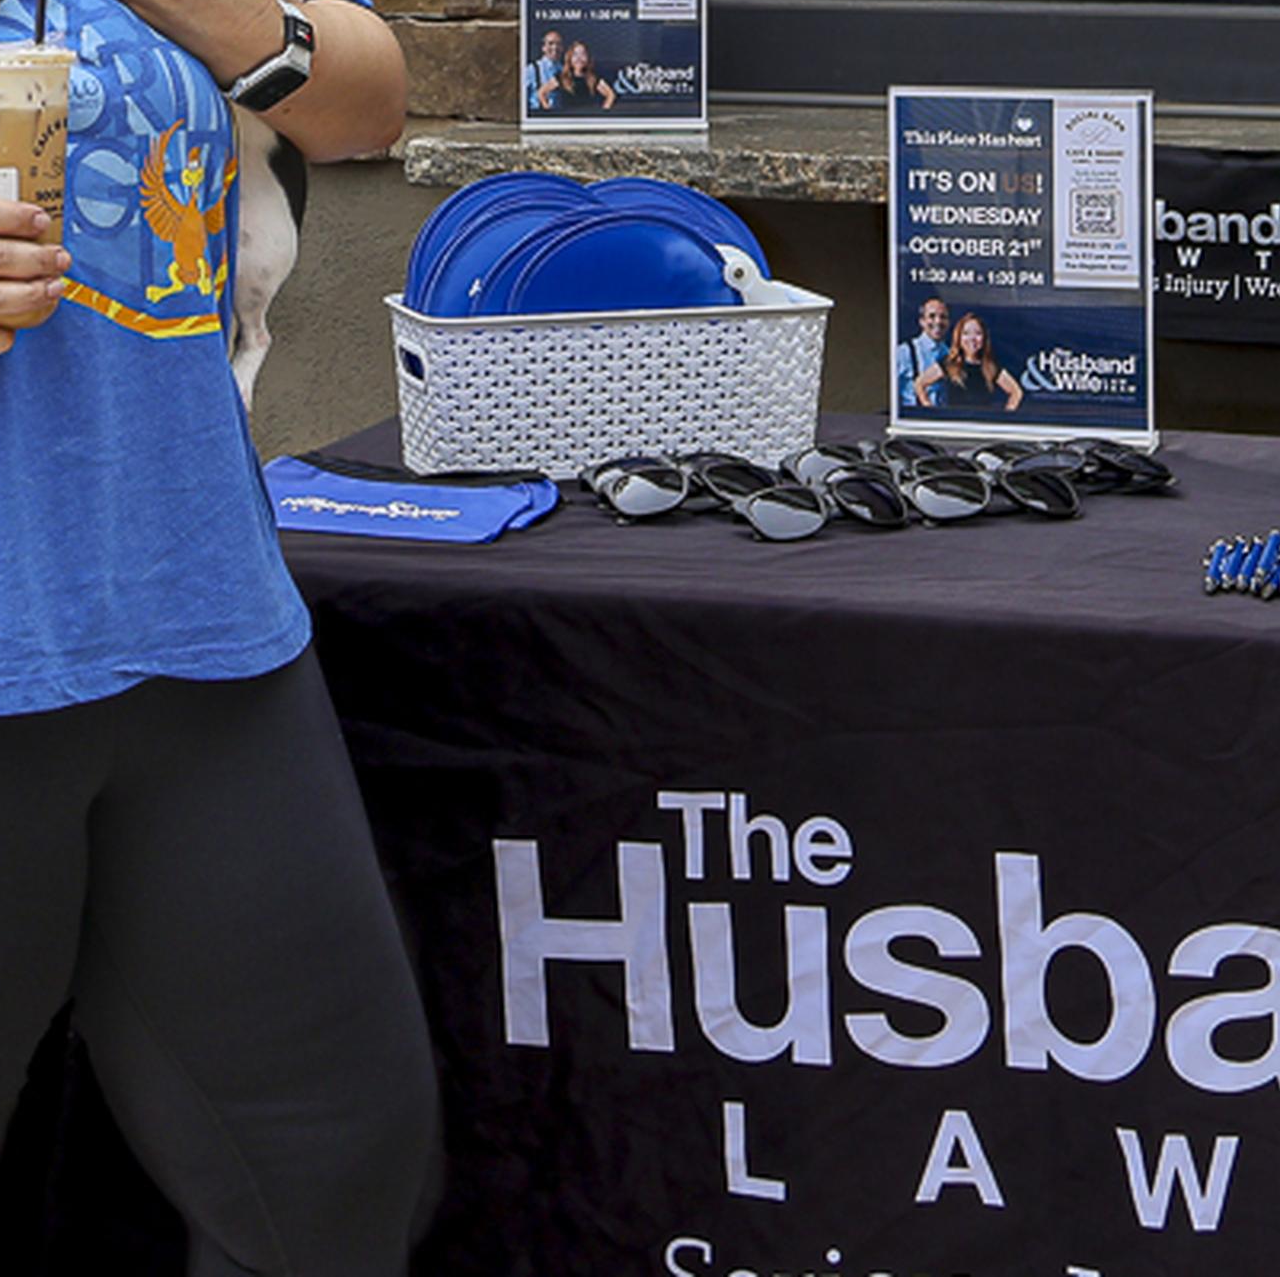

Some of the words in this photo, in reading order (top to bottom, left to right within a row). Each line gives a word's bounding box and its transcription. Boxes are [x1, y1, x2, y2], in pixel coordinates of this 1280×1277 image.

[903, 129, 936, 145] This
[937, 129, 977, 146] Place
[908, 169, 953, 193] IT'S
[957, 170, 997, 193] ON
[908, 203, 1042, 226] WEDNESDAY
[908, 235, 1006, 257] OCTOBER
[948, 269, 975, 283] AM
[1018, 270, 1045, 286] PM
[1164, 273, 1230, 300] Injury
[1039, 351, 1137, 375] Husband
[656, 790, 855, 886] The
